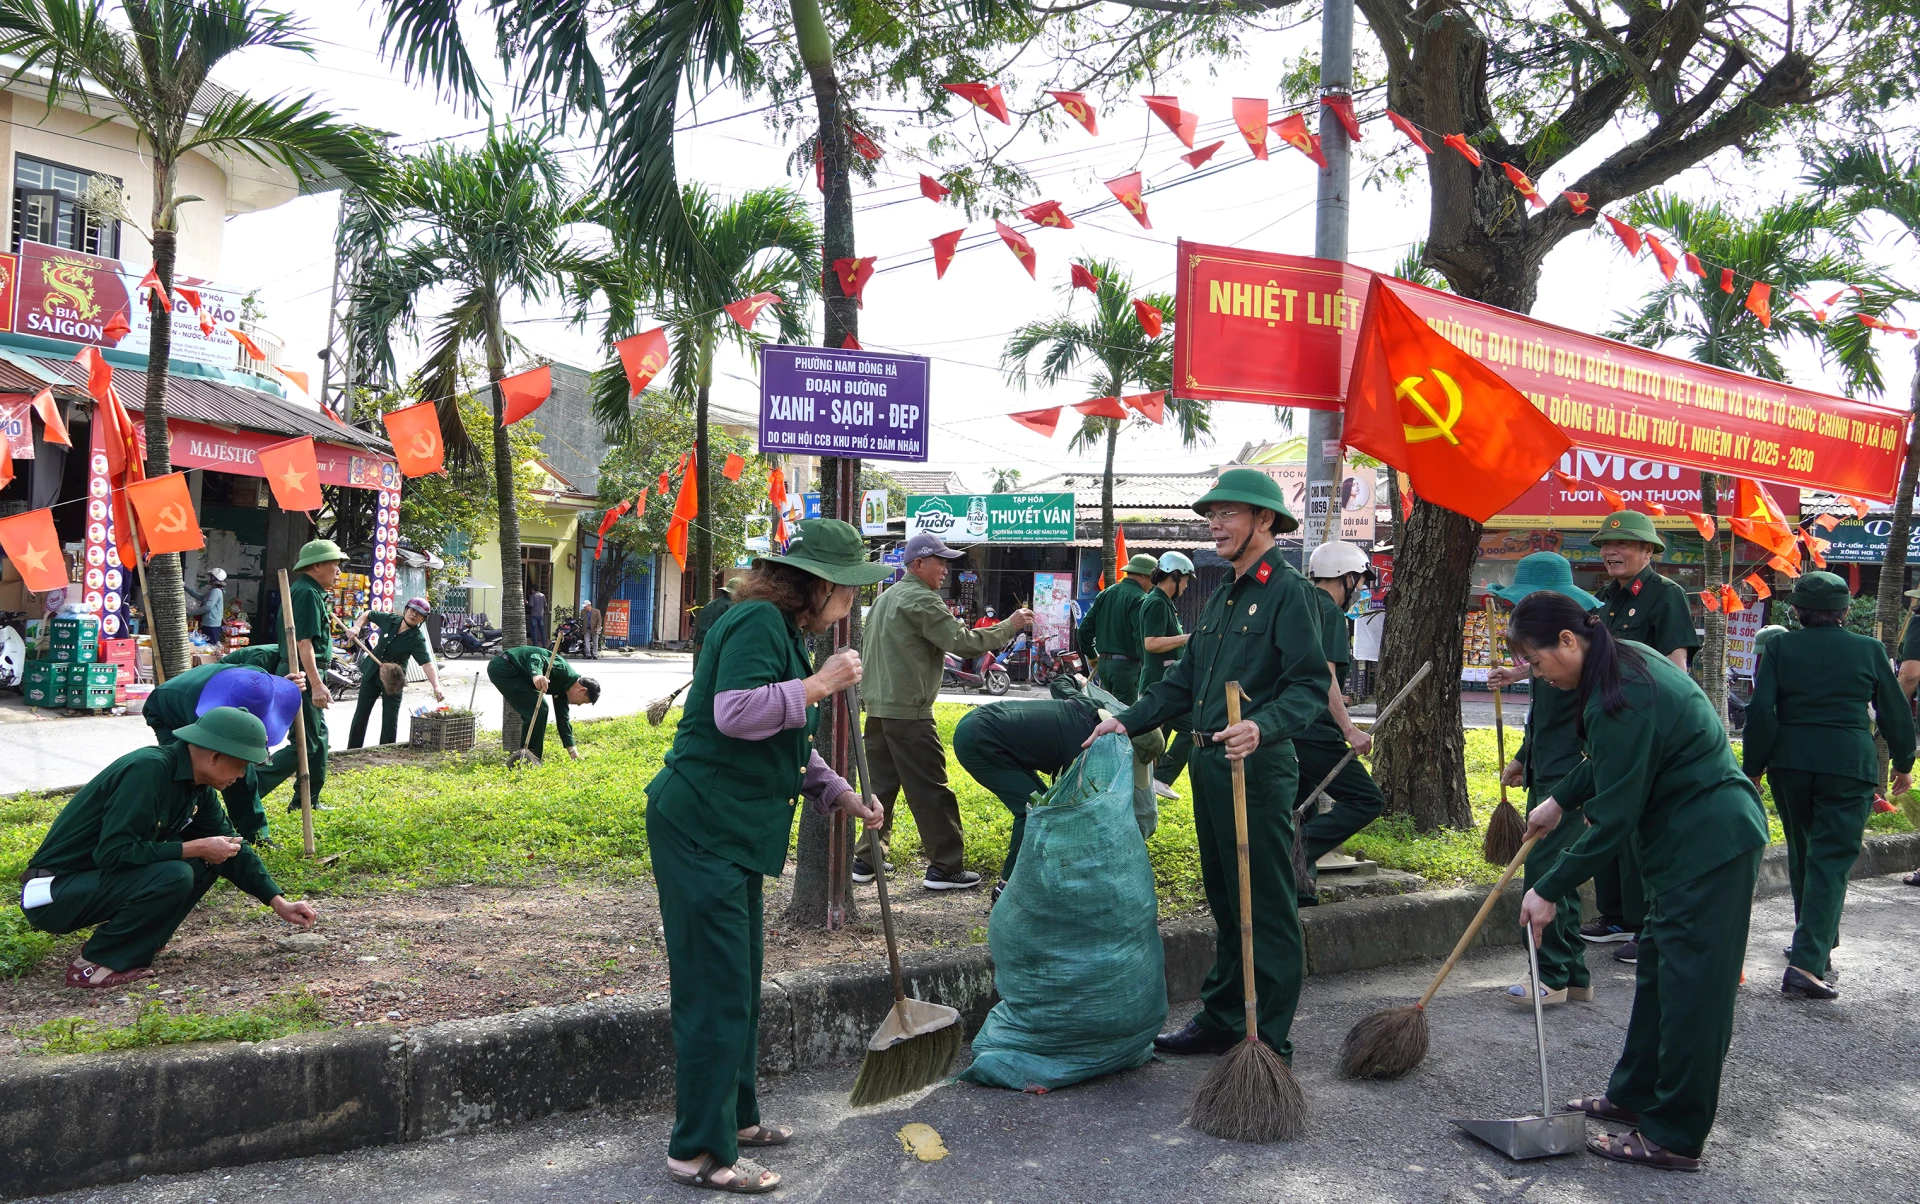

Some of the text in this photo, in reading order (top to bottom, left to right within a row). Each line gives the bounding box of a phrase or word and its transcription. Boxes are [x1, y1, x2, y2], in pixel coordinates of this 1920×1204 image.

[55, 307, 80, 320] BIA
[1209, 279, 1360, 335] NHIỆT LIỆT
[27, 312, 104, 341] SAIGON
[173, 322, 193, 331] CUNG
[795, 356, 898, 377] PHƯỜNG NAM ĐÔNG HÀ
[805, 377, 887, 397] ĐOẠN ĐƯỜNG
[1488, 332, 1517, 371] ĐẠI
[1522, 338, 1550, 378] HỘI
[1554, 348, 1582, 385] ĐẠI
[1585, 349, 1619, 389] BIỂU
[1623, 364, 1660, 401] MTTQ
[1665, 373, 1693, 409] VIỆT
[1695, 382, 1726, 413] NAM
[1728, 387, 1743, 417] VÀ
[1746, 392, 1770, 422] CÁC
[1772, 394, 1787, 426] TỔ
[1788, 404, 1817, 433] CHỨC
[1818, 411, 1850, 440] CHÍNH
[1851, 420, 1866, 449] TRỊ
[1866, 422, 1881, 448] XÃ
[1880, 425, 1898, 455] HỘI
[769, 395, 815, 422] XANH
[831, 398, 874, 430] SẠCH
[889, 403, 920, 434] ĐẸP
[768, 431, 920, 454] DO CHI HỘI CCB KHU PHỐ 2 ĐẢM NHẬN
[1549, 394, 1592, 432] ĐÔNG
[1596, 403, 1616, 436] HÀ
[1620, 404, 1648, 442] LẦN
[1652, 416, 1679, 447] THỨ
[1690, 425, 1733, 460] NHIỆM
[1734, 432, 1751, 460] KỲ
[1751, 439, 1780, 466] 2025
[1787, 446, 1814, 473] 2030
[190, 439, 257, 465] MAJESTIC
[1278, 470, 1296, 478] TÓC
[1013, 495, 1044, 504] TẠP HÓA
[1310, 486, 1320, 498] CHO
[1645, 489, 1701, 504] THƯỢN
[990, 505, 1071, 525] THUYẾT VÂN
[1343, 518, 1355, 529] GỘI
[606, 607, 628, 623] TIẾN
[1741, 613, 1759, 627] TIỆC
[1739, 624, 1756, 637] SỐC
